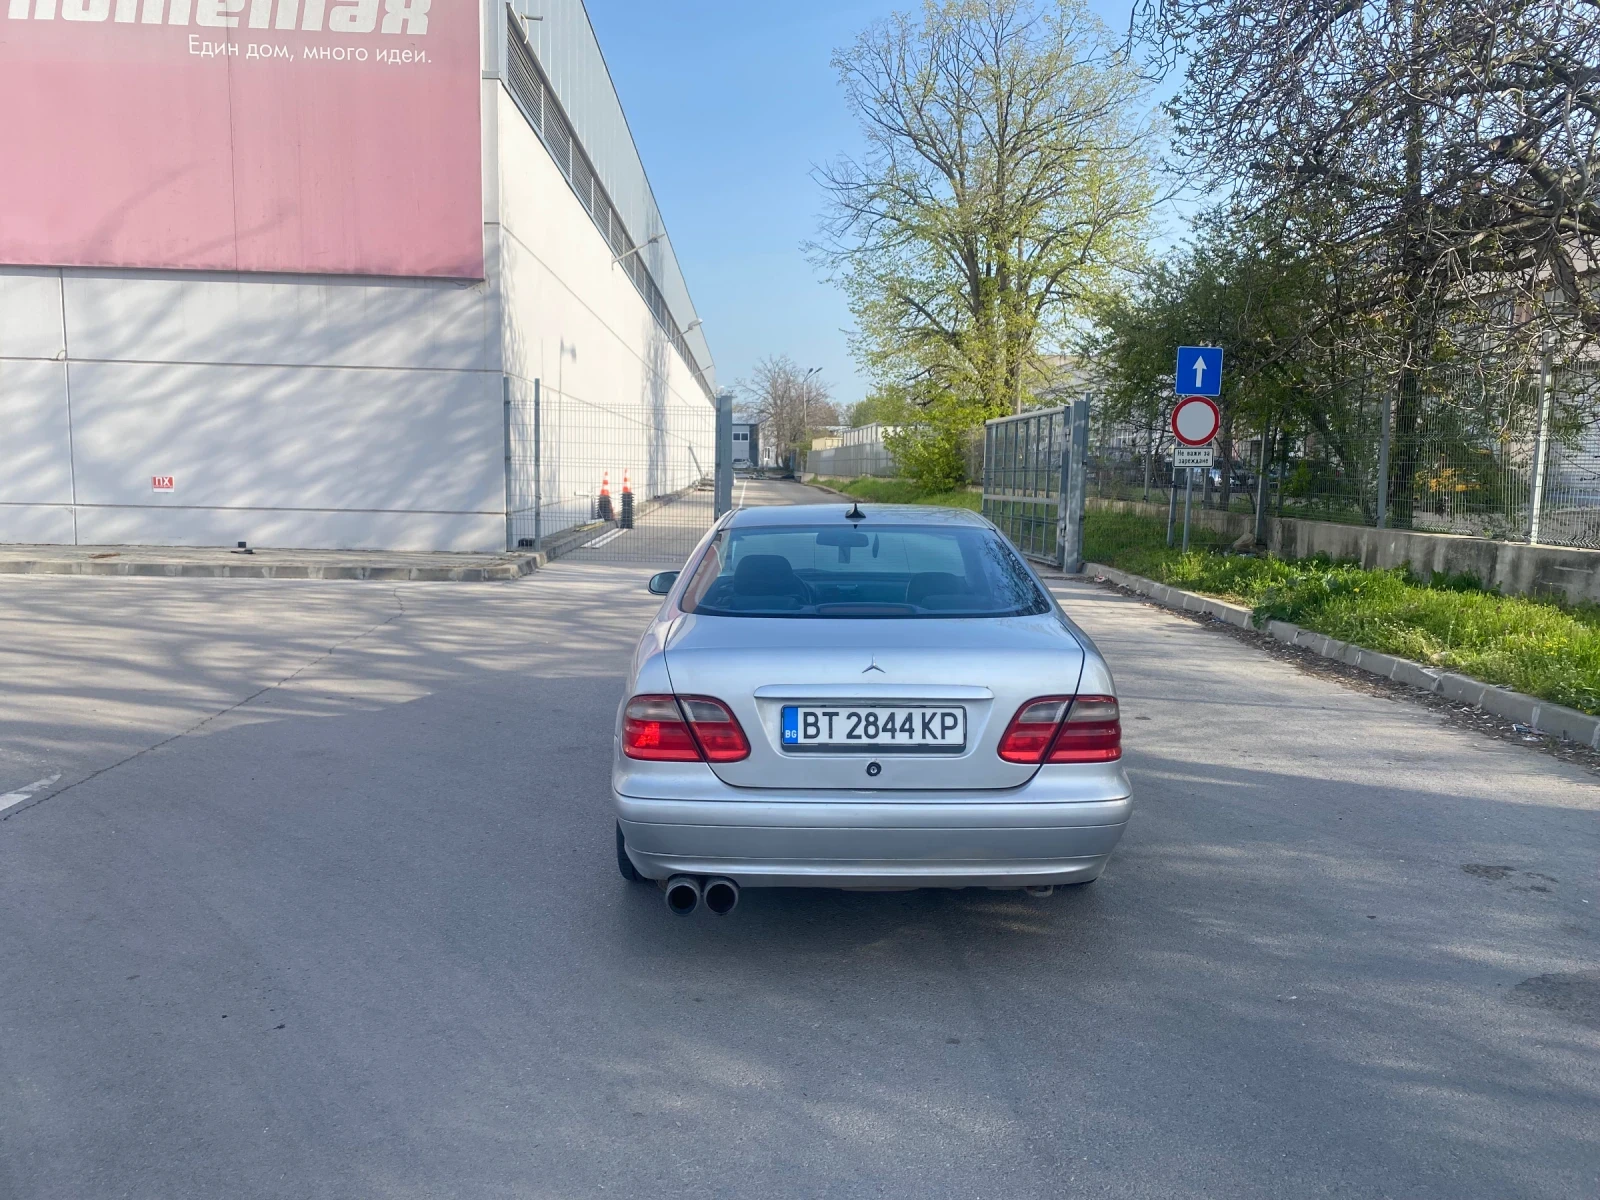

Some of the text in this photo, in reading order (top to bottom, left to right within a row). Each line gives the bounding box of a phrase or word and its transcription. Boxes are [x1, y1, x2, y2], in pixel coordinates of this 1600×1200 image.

[188, 34, 432, 65] Един дом, много идеи.
[785, 711, 958, 739] BG BT 2844 KP
